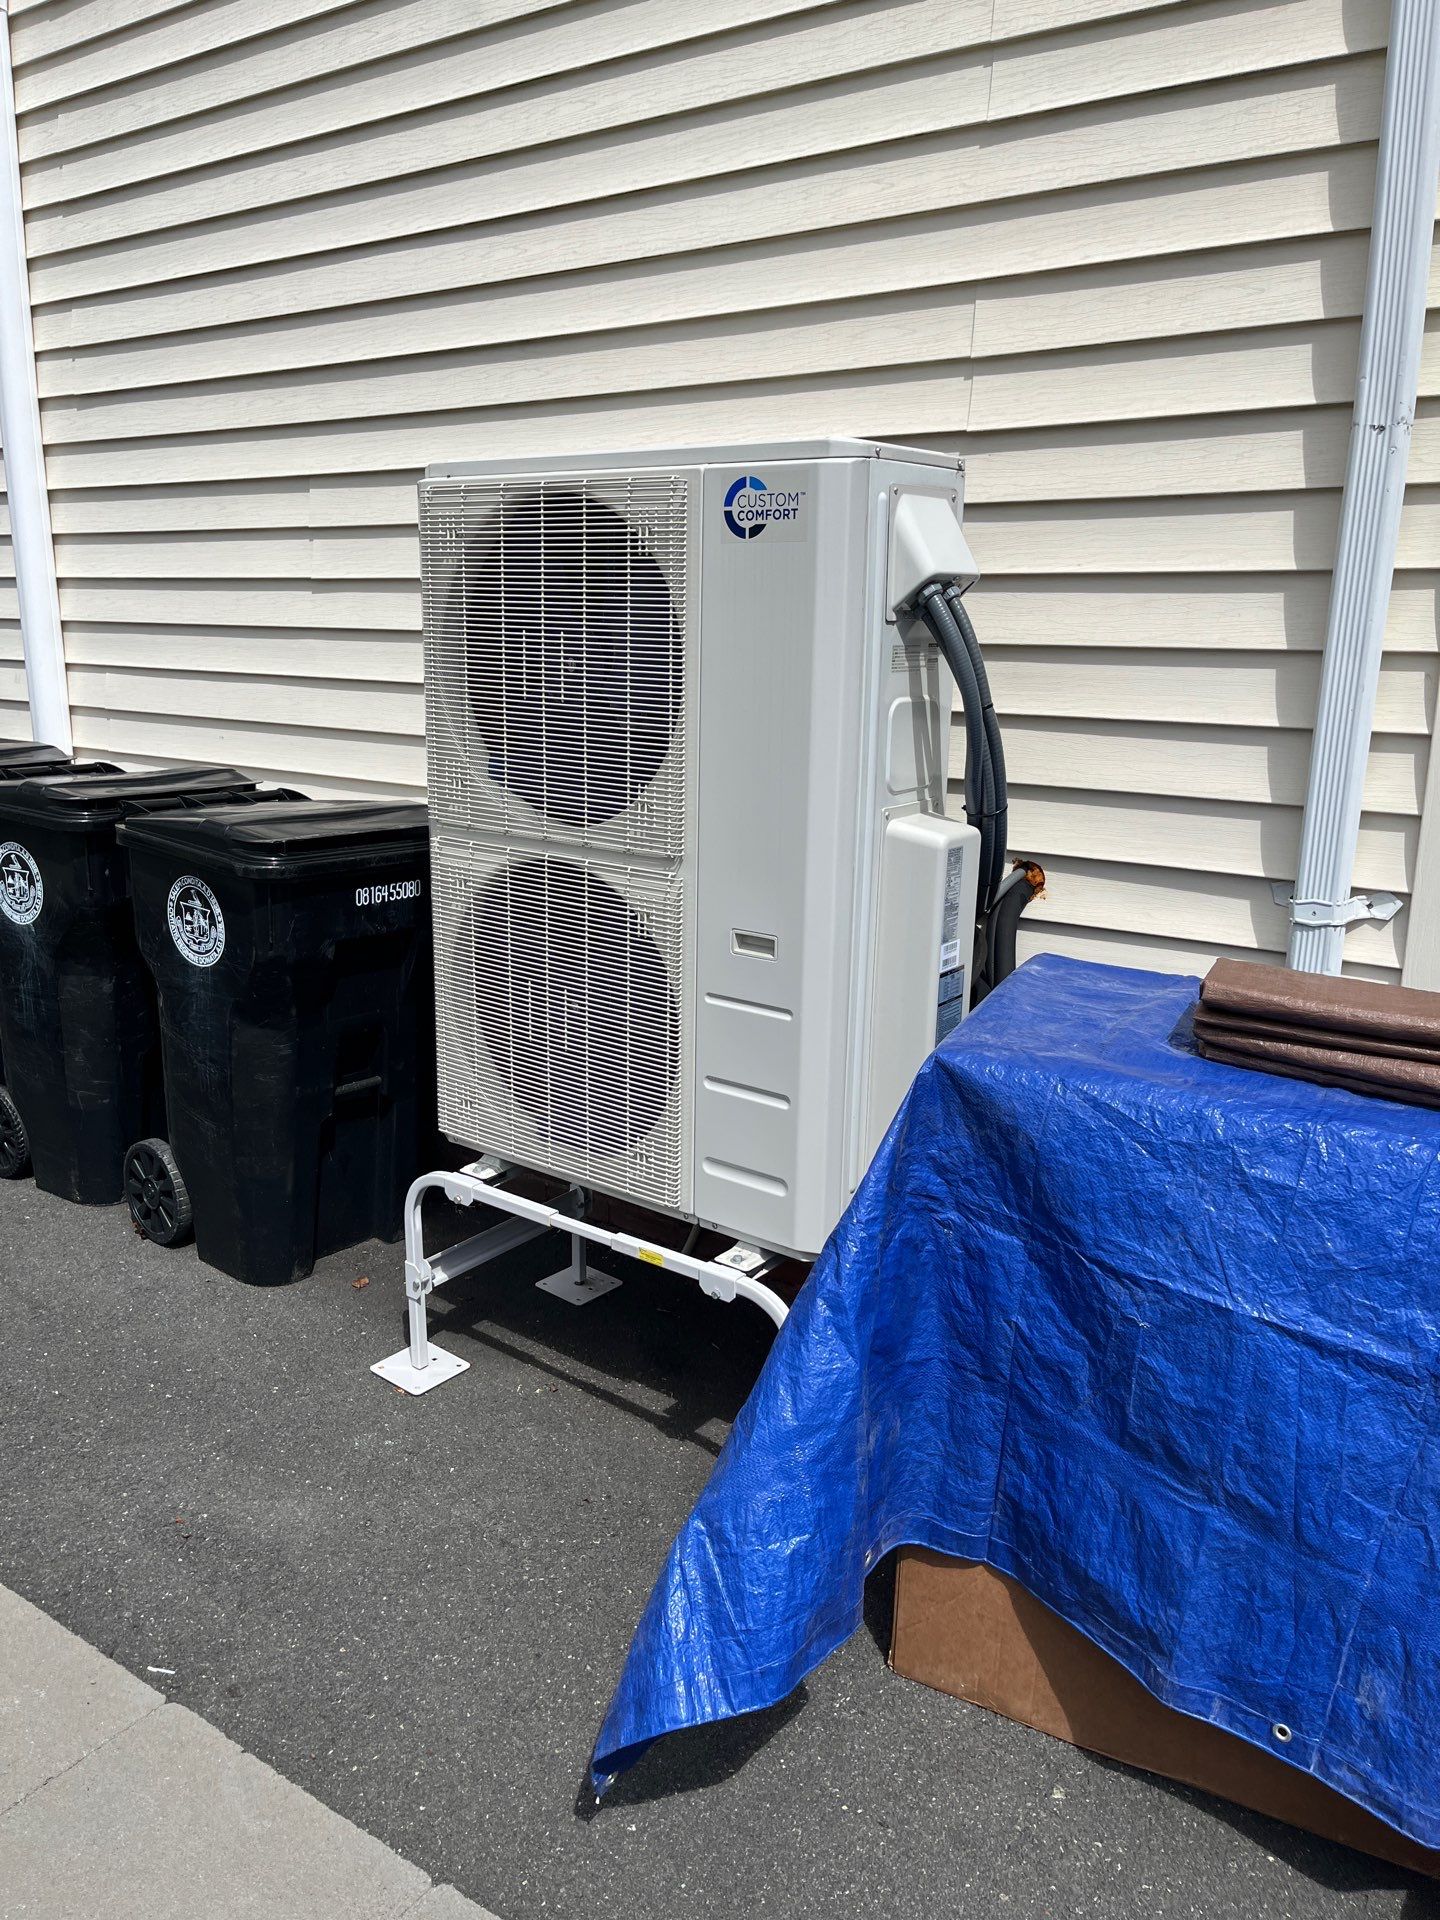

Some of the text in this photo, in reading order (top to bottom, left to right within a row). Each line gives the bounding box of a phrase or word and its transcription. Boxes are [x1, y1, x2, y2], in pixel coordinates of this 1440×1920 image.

[737, 492, 799, 509] CUSTOM
[737, 508, 799, 521] COMFORT
[356, 879, 421, 907] 0816455080
